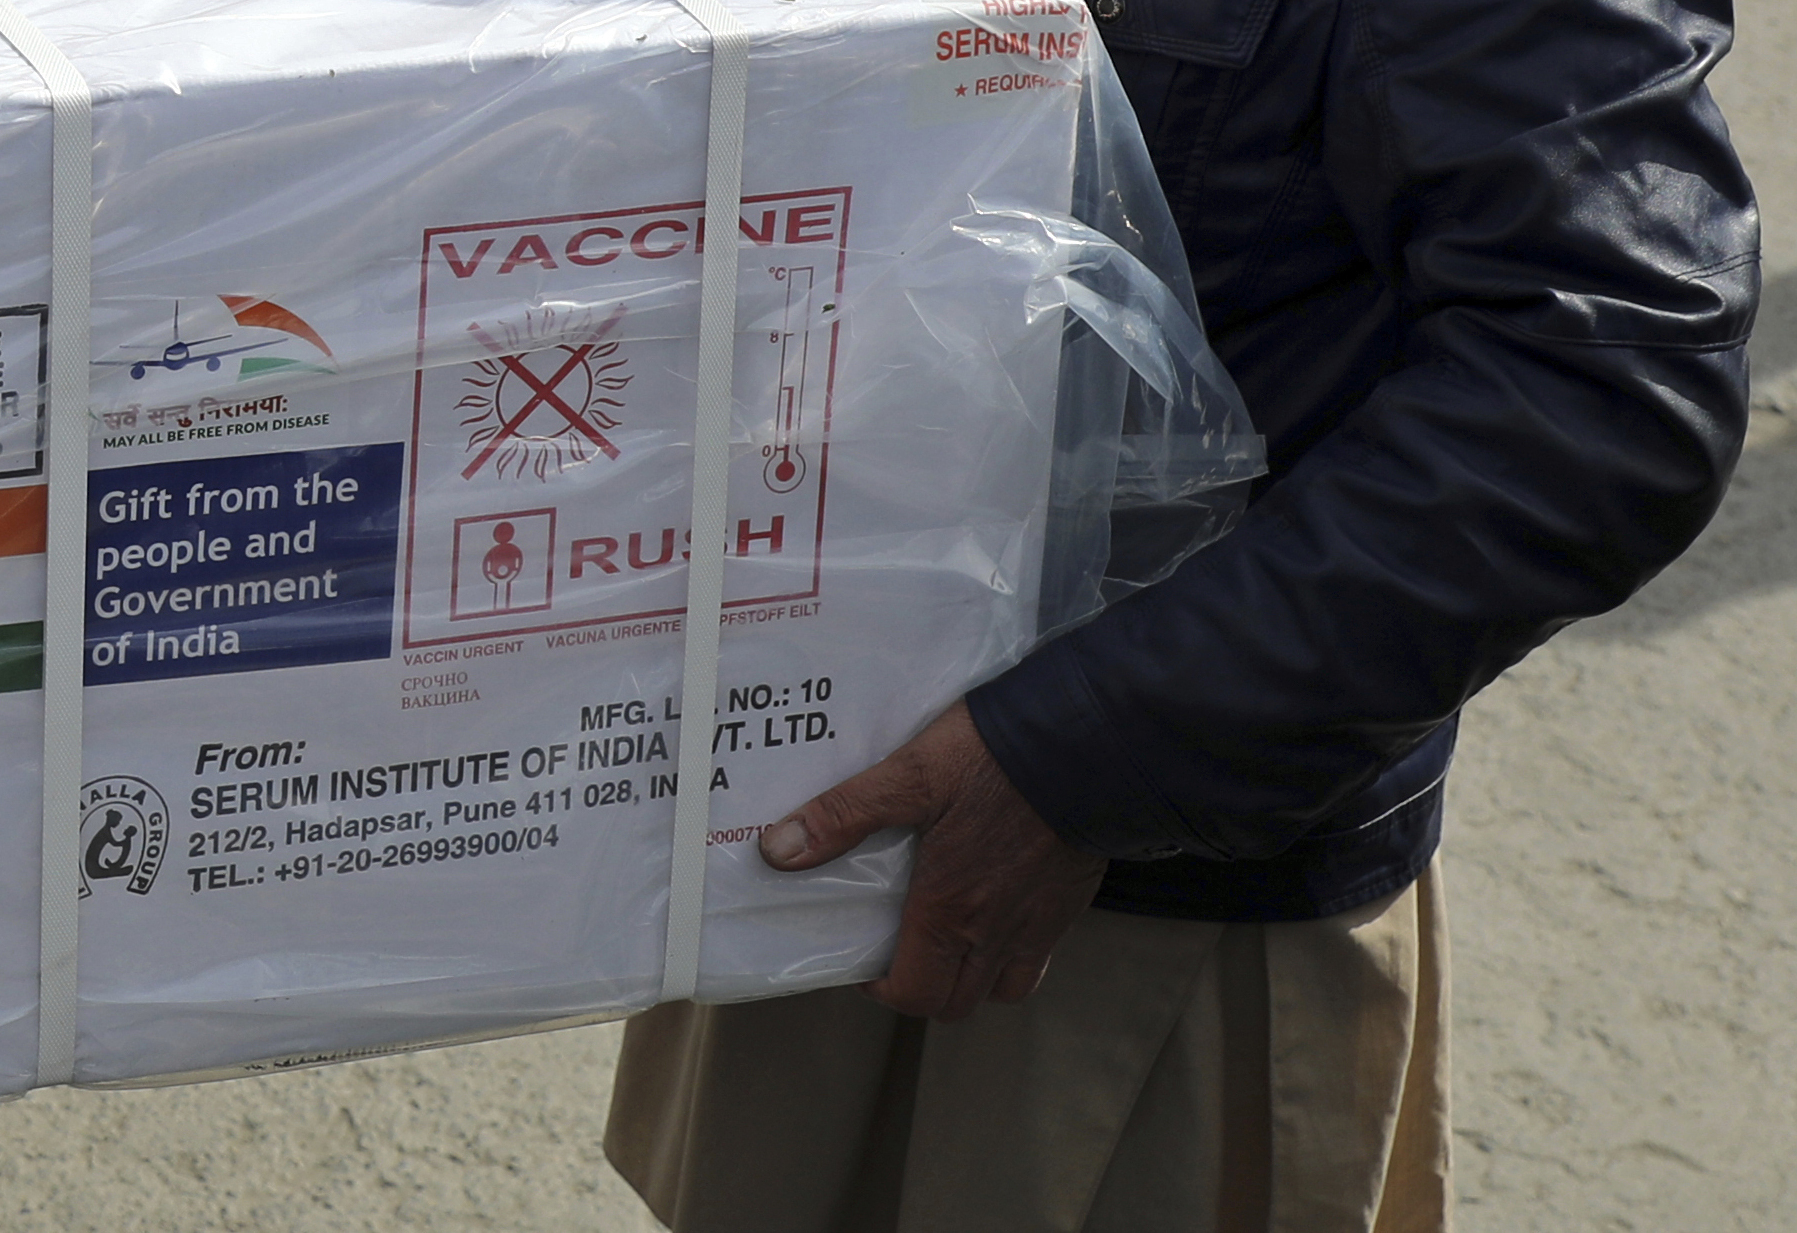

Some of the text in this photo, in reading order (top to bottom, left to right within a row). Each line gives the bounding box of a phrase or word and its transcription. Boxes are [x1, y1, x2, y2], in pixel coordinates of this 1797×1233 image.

[936, 28, 1030, 61] SERUM
[103, 435, 135, 449] MAY
[138, 432, 163, 445] ALL
[188, 426, 223, 439] FREE
[226, 421, 268, 436] FROM
[272, 414, 330, 431] DISEASE
[99, 471, 359, 524] Gift from the
[96, 520, 316, 579] people and
[94, 568, 338, 619] Government
[91, 625, 241, 666] of India
[403, 602, 822, 667] VACCIN URGENT VACUNA URGENTE EILT
[400, 688, 481, 710] ВАКЦИНА
[401, 671, 469, 692] СРОЧНО
[580, 701, 654, 732] MFG.
[728, 683, 790, 714] NO.:
[800, 677, 833, 704] 10
[190, 710, 836, 819] SERUM INSTITUTE OF INDIA LTD.
[194, 740, 306, 775] From:
[188, 766, 730, 857] 212/2, Hadapsar, Pune 411 028, INA
[135, 810, 163, 891] GROUP
[187, 823, 559, 893] TEL.: +91-20-26993900/04
